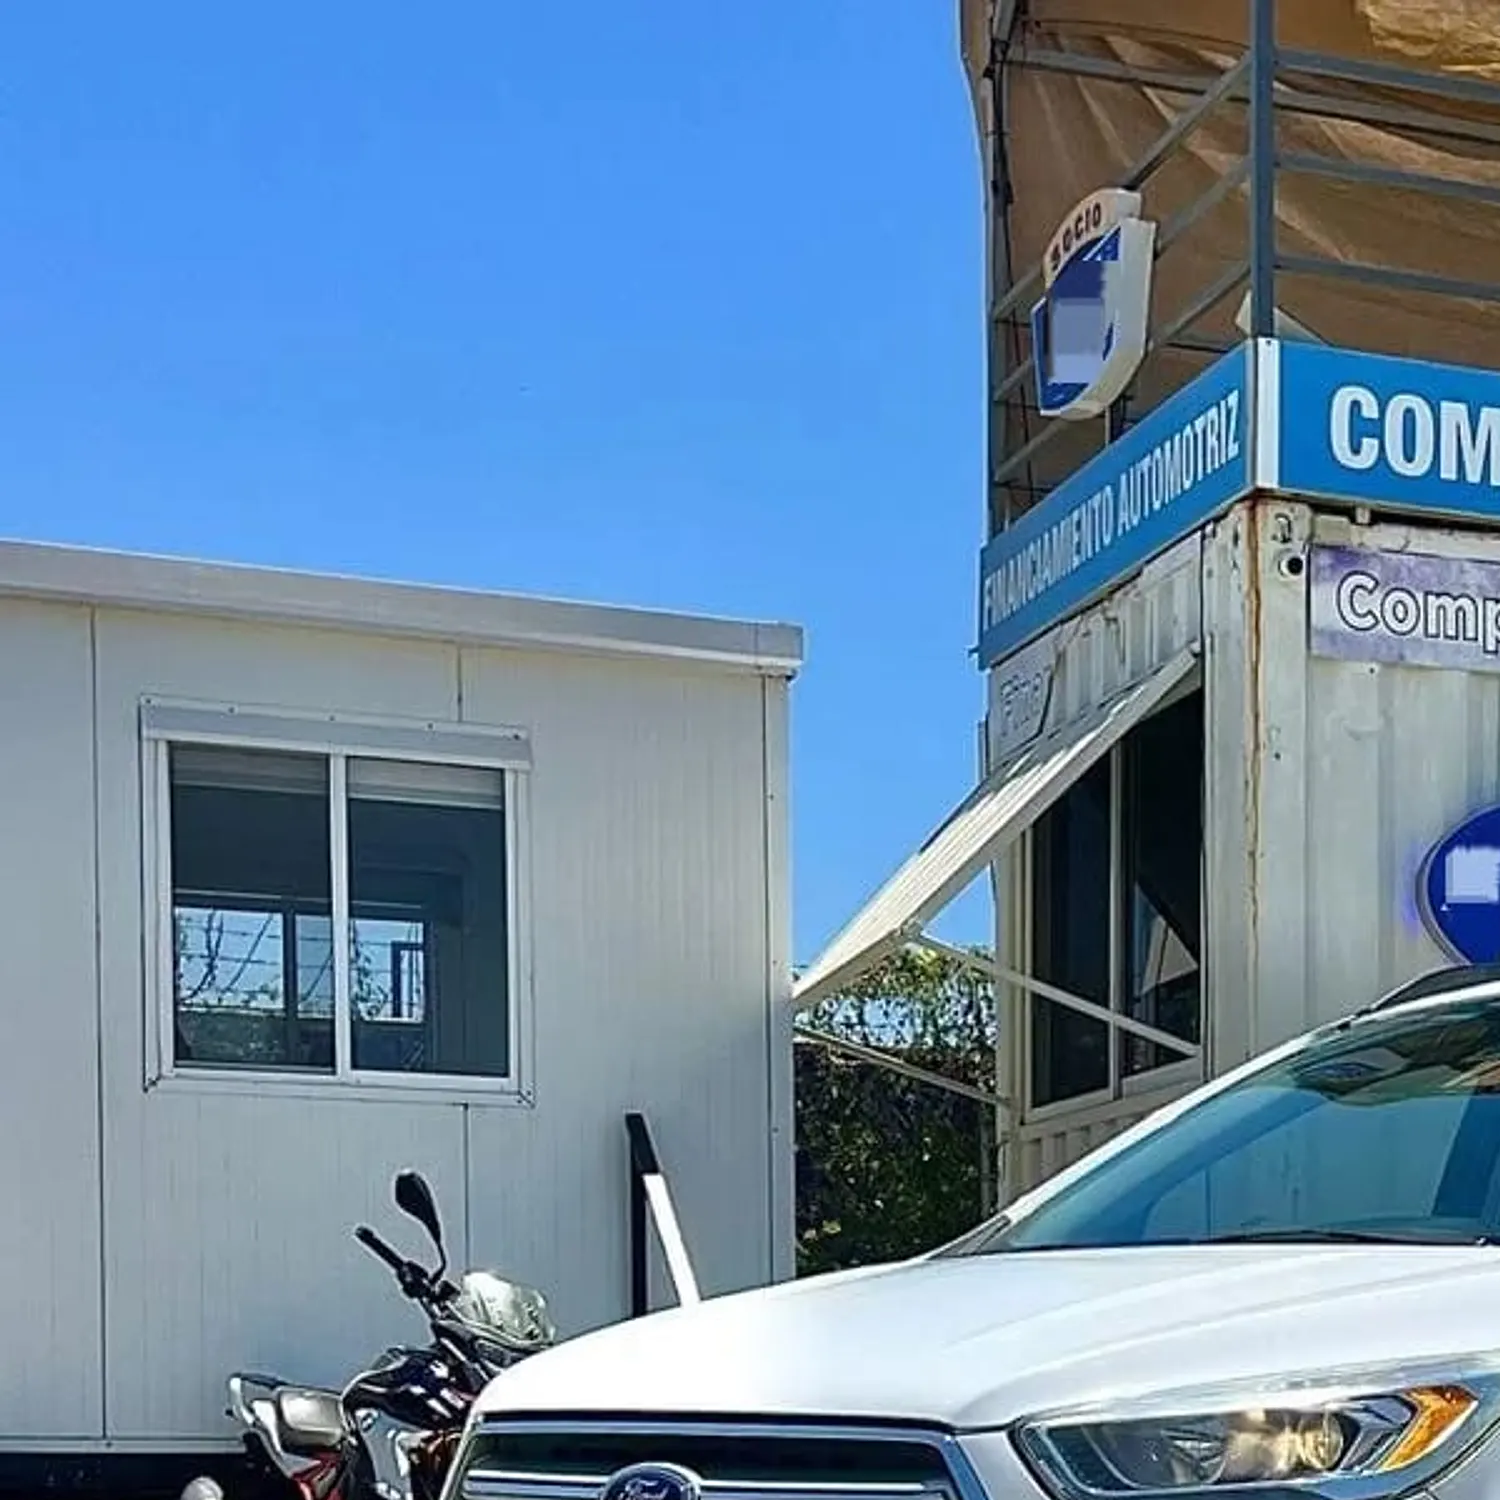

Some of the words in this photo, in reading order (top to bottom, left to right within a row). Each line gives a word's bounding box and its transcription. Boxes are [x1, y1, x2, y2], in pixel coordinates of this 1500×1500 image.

[1051, 201, 1102, 272] SOCIO
[983, 484, 1114, 632] FINANCIAMIENTO
[1117, 388, 1240, 537] AUTOMOTRIZ
